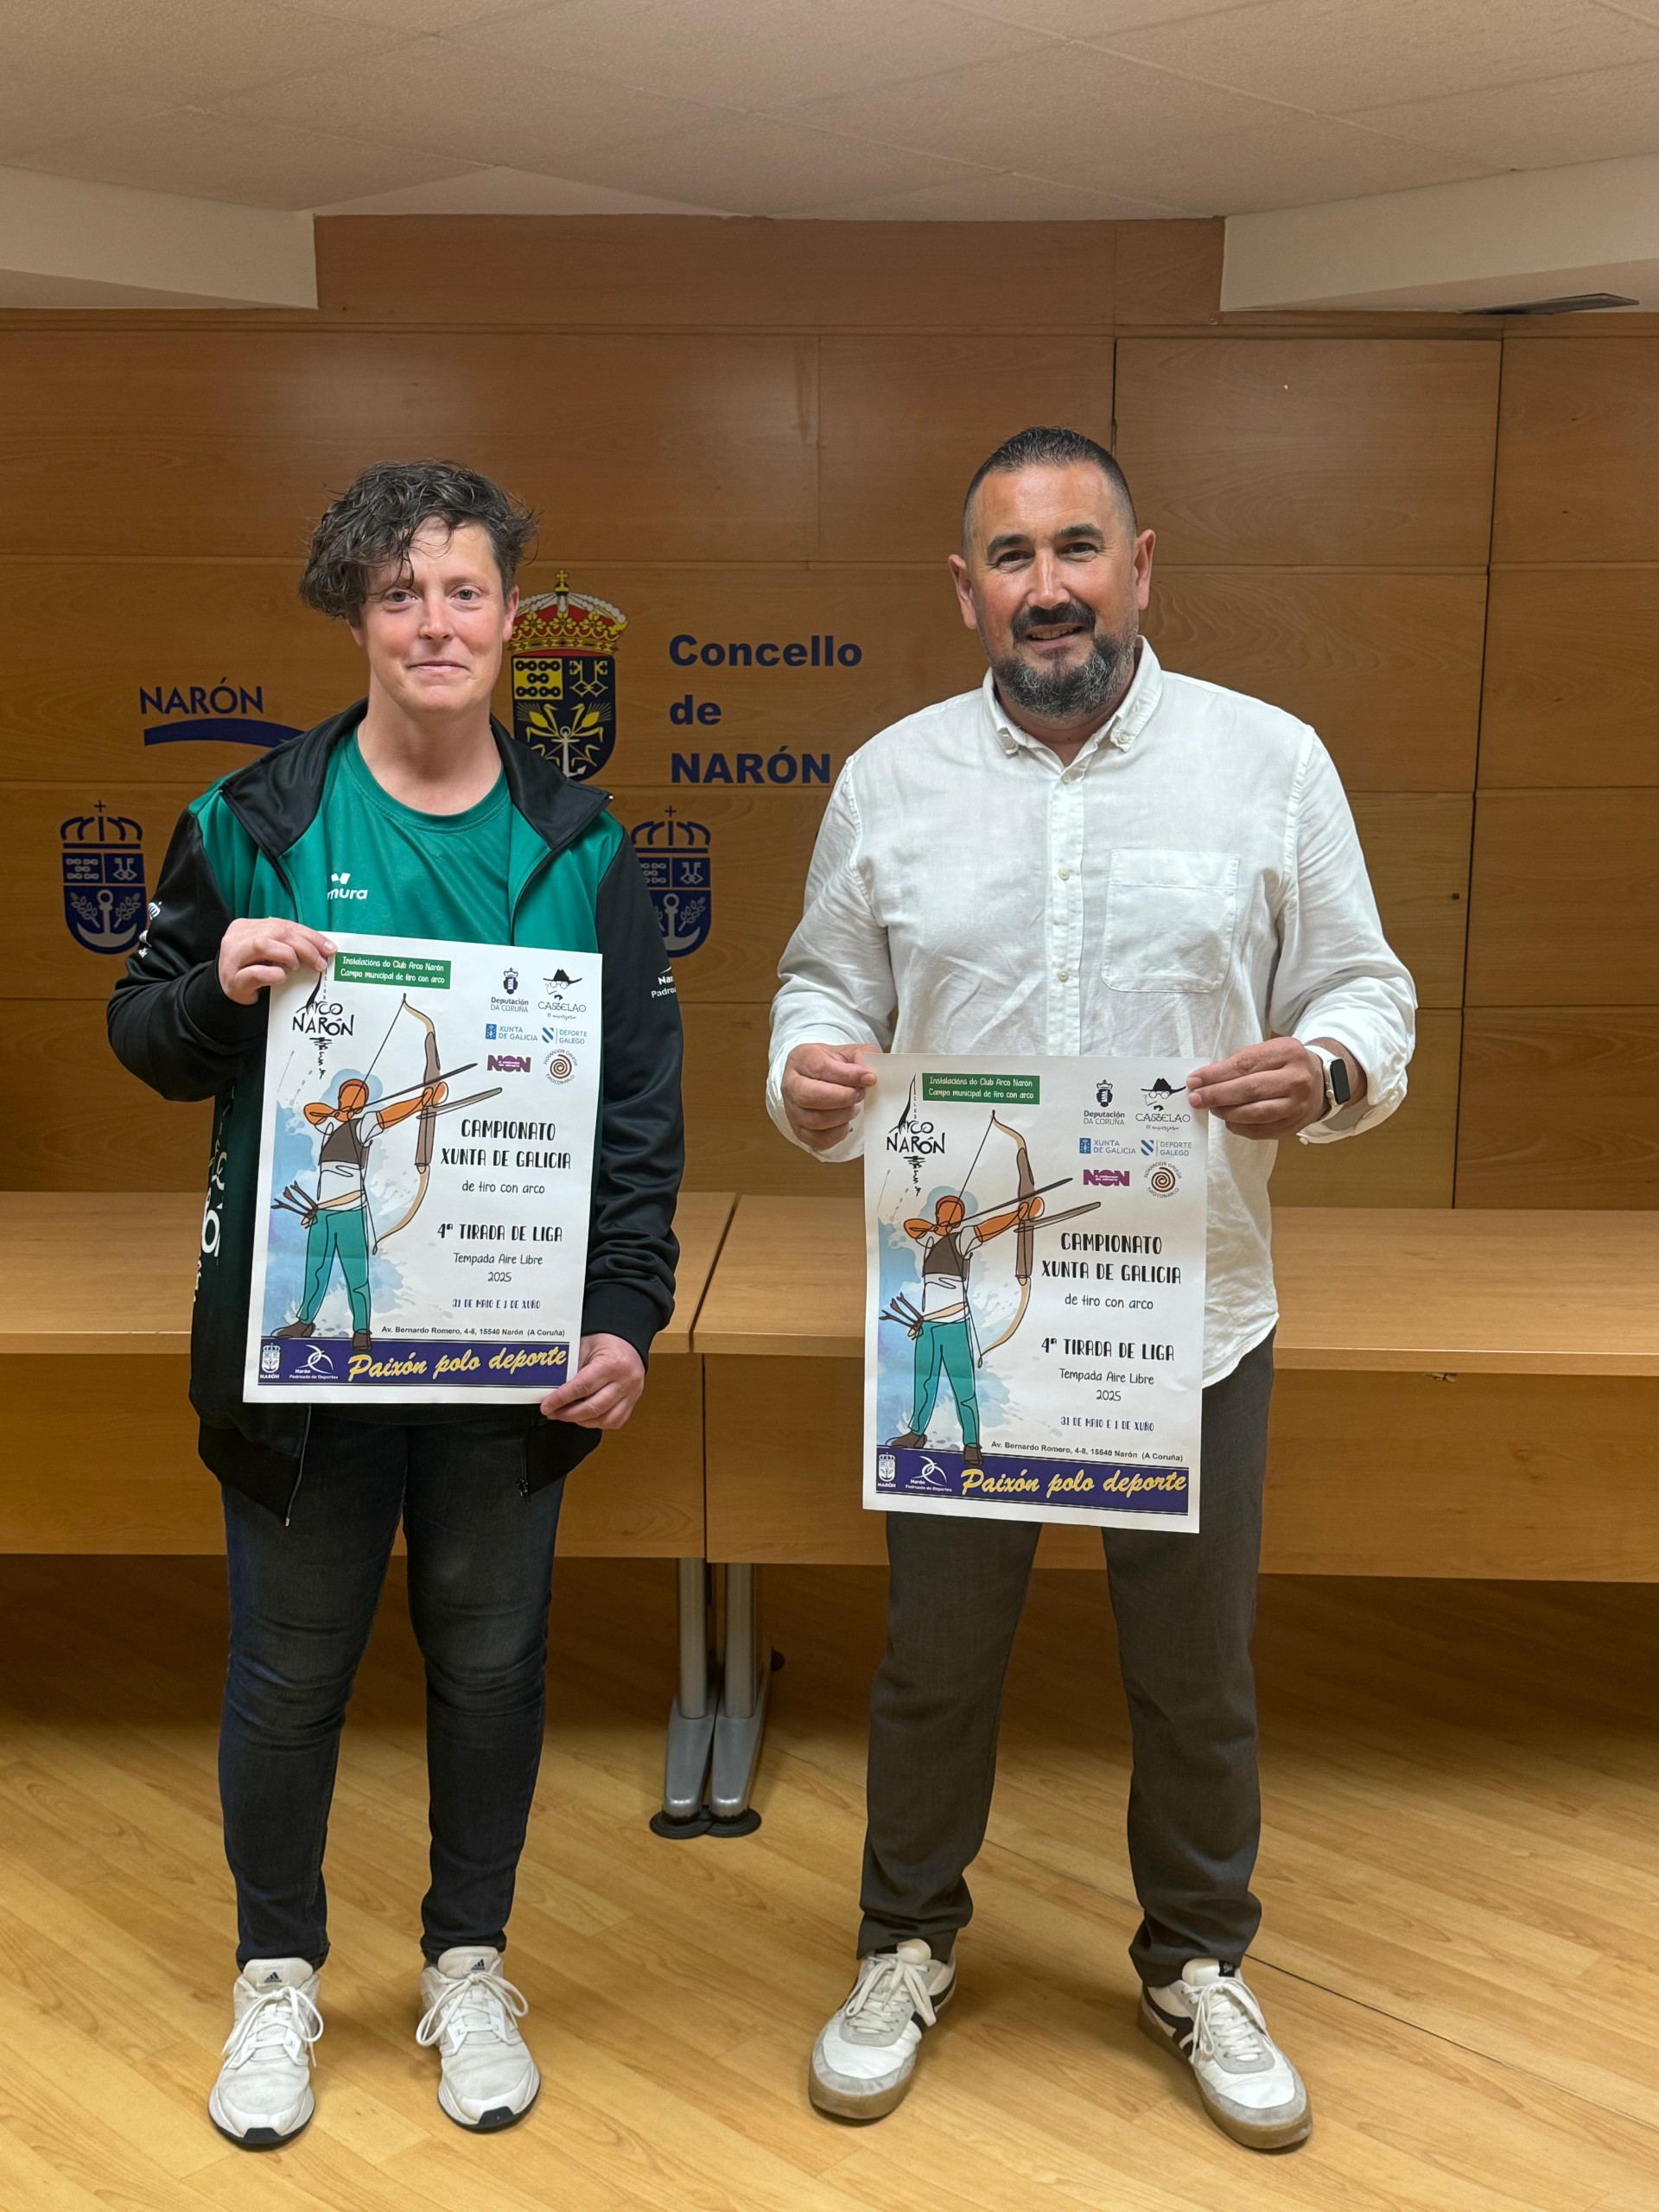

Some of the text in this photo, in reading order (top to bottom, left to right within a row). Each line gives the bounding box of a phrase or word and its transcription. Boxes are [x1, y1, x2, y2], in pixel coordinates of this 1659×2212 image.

[669, 634, 862, 667] Concello
[139, 677, 264, 715] NARÓN
[669, 694, 721, 725] de
[671, 746, 830, 784] NARÓN
[342, 956, 380, 967] Instalacións
[392, 960, 406, 969] Club
[425, 963, 444, 972] Narón
[340, 969, 362, 979] Campo
[365, 971, 393, 981] municipal
[396, 972, 404, 981] de
[658, 976, 675, 985] Nar
[491, 996, 529, 1006] Deputación
[292, 1013, 354, 1036] NARÓN
[486, 1054, 531, 1072] NON
[929, 1077, 968, 1085] Instalacións
[980, 1077, 995, 1086] Club
[1013, 1078, 1033, 1087] Narón
[928, 1087, 950, 1097] Campo
[952, 1090, 982, 1098] municipal
[1084, 1110, 1125, 1119] Deputación
[461, 1119, 556, 1141] CAMPIONATO
[887, 1132, 945, 1154] NARÓN
[441, 1147, 571, 1169] XUNTA DE GALICIA
[1083, 1169, 1130, 1186] NON
[461, 1179, 545, 1194] de tiro con arco
[459, 1224, 505, 1241] TIRADA
[512, 1225, 527, 1241] DE
[532, 1226, 563, 1243] LIGA
[1060, 1232, 1162, 1255] CAMPIONATO
[453, 1252, 543, 1266] Tempada Aire Libre
[487, 1271, 512, 1282] 2025
[1041, 1260, 1181, 1284] XUNTA DE GALICIA
[452, 1299, 461, 1308] 31
[464, 1299, 473, 1308] DE
[476, 1299, 494, 1308] MAIO
[496, 1300, 501, 1308] E
[510, 1300, 519, 1309] DE
[1065, 1293, 1154, 1310] de tiro con arco
[1063, 1338, 1112, 1357] TIRADA
[1119, 1342, 1135, 1358] DE
[1141, 1344, 1175, 1361] LIGA
[347, 1346, 567, 1382] Paixón polo deporte
[1058, 1368, 1154, 1384] Tempada Aire Libre
[1096, 1389, 1122, 1402] 2025
[1060, 1415, 1070, 1426] 31
[1072, 1417, 1082, 1427] DE
[1085, 1418, 1103, 1428] MAIO
[1106, 1420, 1111, 1428] E
[1122, 1421, 1131, 1430] DE
[1134, 1421, 1154, 1432] XUÑO
[1004, 1442, 1039, 1451] Bernardo
[1040, 1444, 1073, 1454] Romero,
[1090, 1448, 1112, 1457] 15540
[1114, 1450, 1138, 1459] Narón
[1141, 1452, 1151, 1460] (A
[1152, 1452, 1183, 1462] Coruña)
[960, 1469, 1187, 1499] Paixón polo deporte
